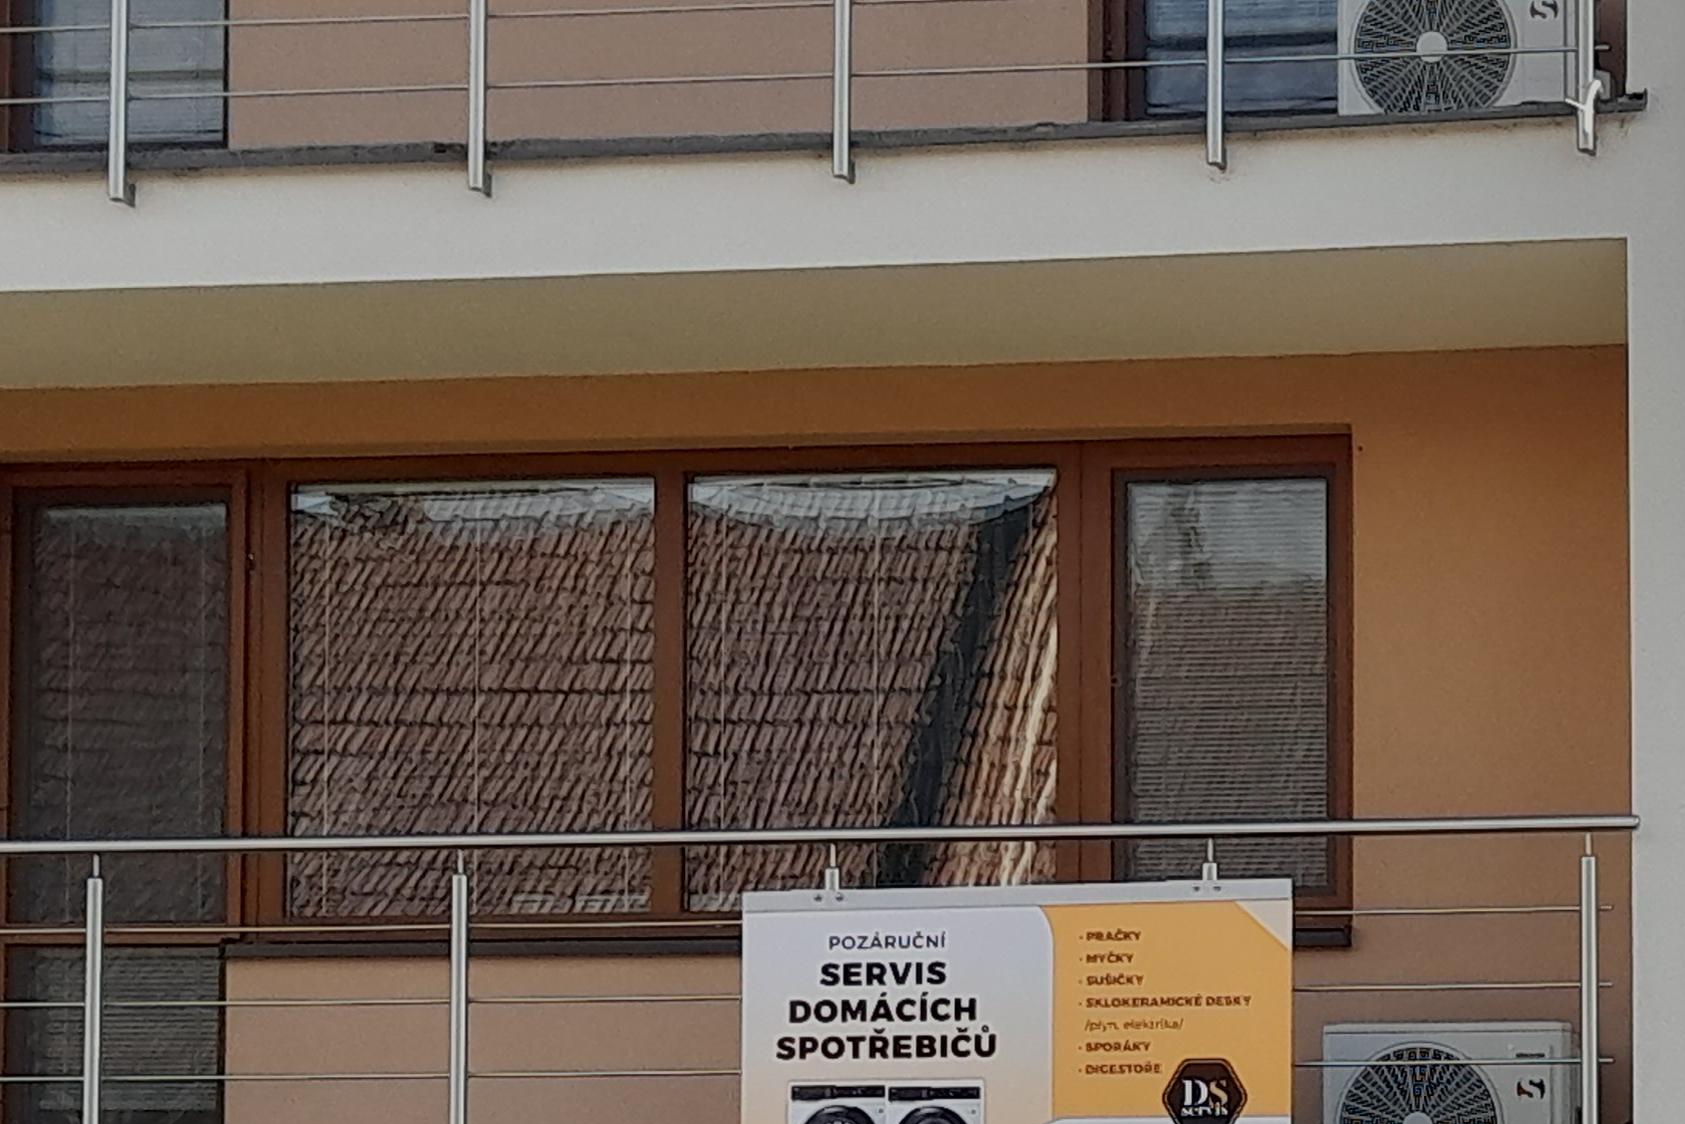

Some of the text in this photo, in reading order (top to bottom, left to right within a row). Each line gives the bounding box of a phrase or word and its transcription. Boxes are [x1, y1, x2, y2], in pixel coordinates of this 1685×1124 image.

[829, 931, 946, 950] POZÁRUČNÍ
[1086, 928, 1141, 941] PRAČKY
[1086, 951, 1133, 963] MYČKY
[820, 961, 947, 986] SERVIS
[1086, 973, 1144, 986] SUŠIČKY
[789, 991, 977, 1023] DOMÁCÍCH
[1086, 994, 1252, 1008] SKLOKERAMICKÉ DESKY
[776, 1025, 996, 1060] SPOTŘEBIČŮ
[1086, 1040, 1151, 1052] SPORÁKY
[1085, 1062, 1162, 1074] DIGESTOŘE
[1181, 1079, 1228, 1106] DS
